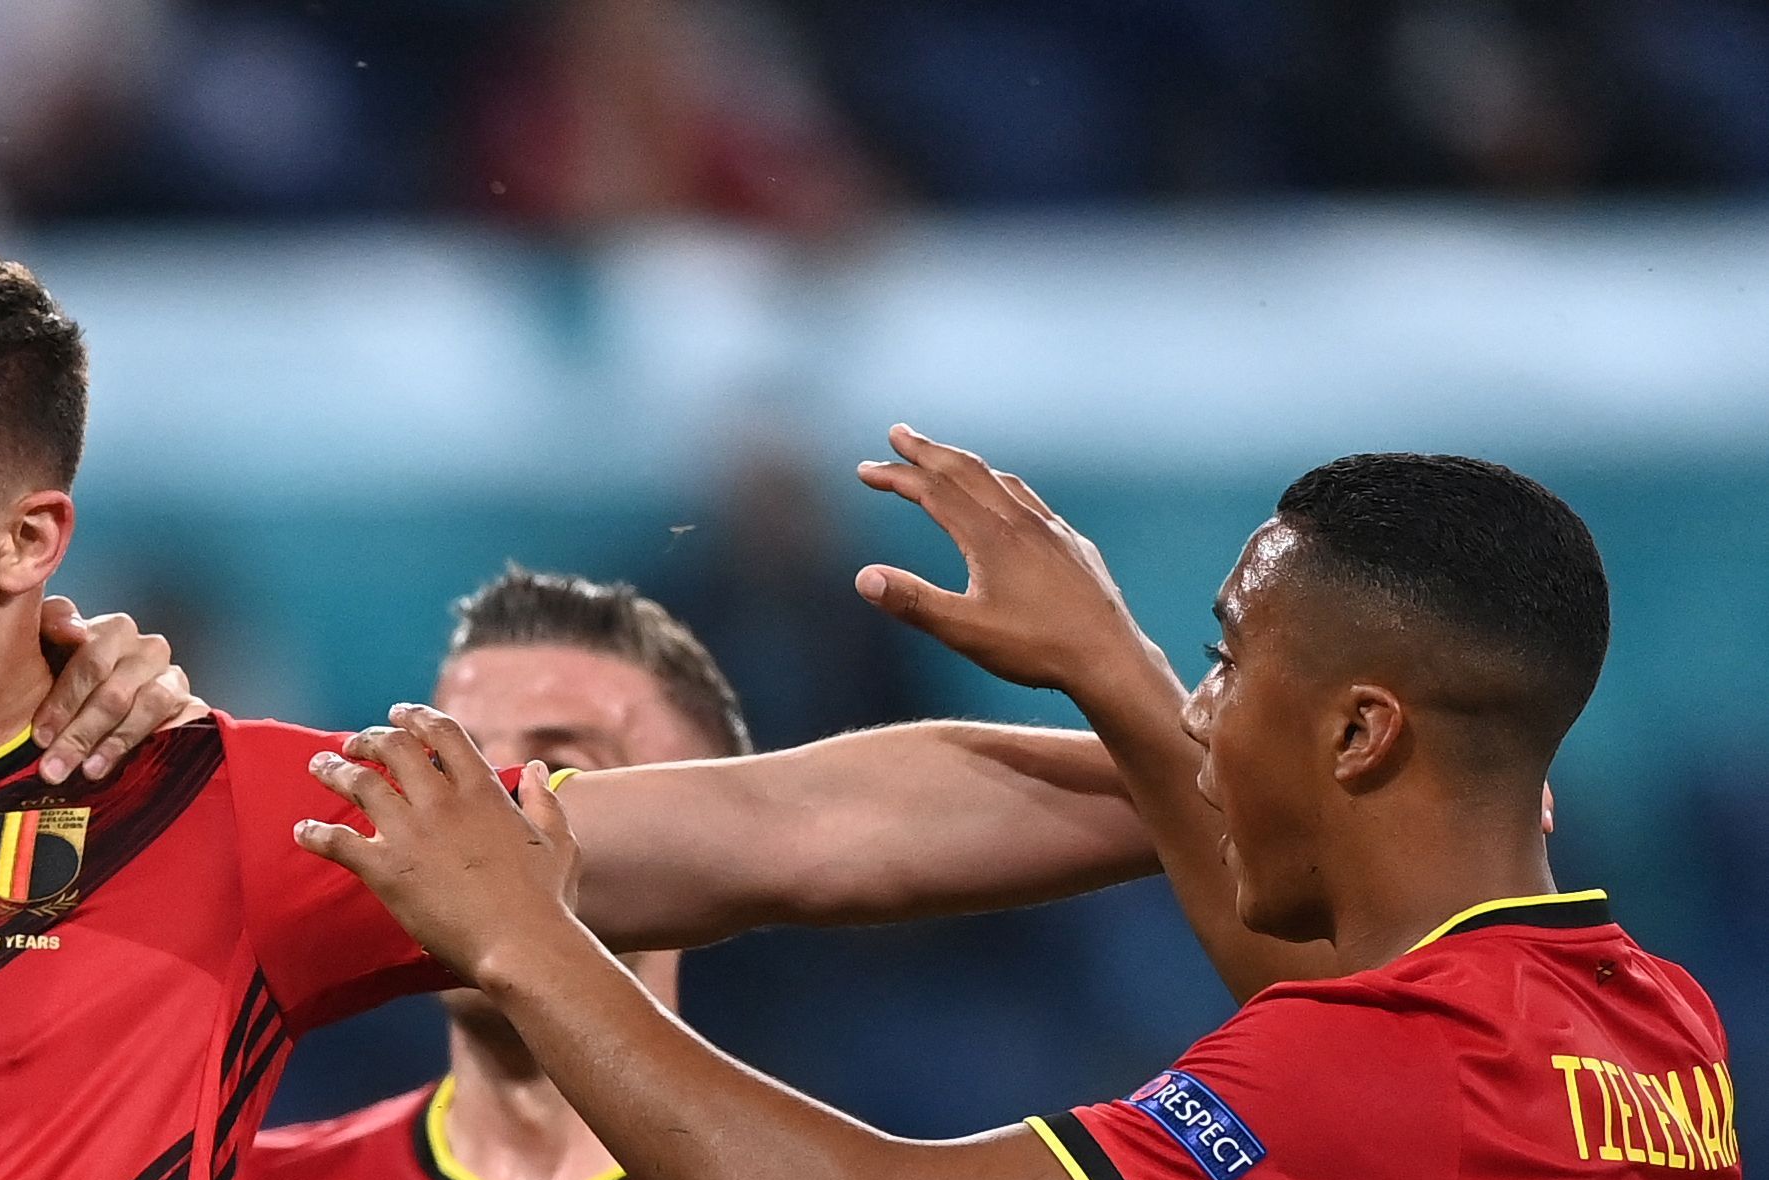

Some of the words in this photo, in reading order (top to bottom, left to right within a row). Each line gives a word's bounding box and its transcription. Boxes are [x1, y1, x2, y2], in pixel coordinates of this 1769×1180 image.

[4, 933, 60, 950] YEARS
[1152, 1083, 1253, 1172] RESPECT
[1551, 1055, 1739, 1170] TIELEMAN
